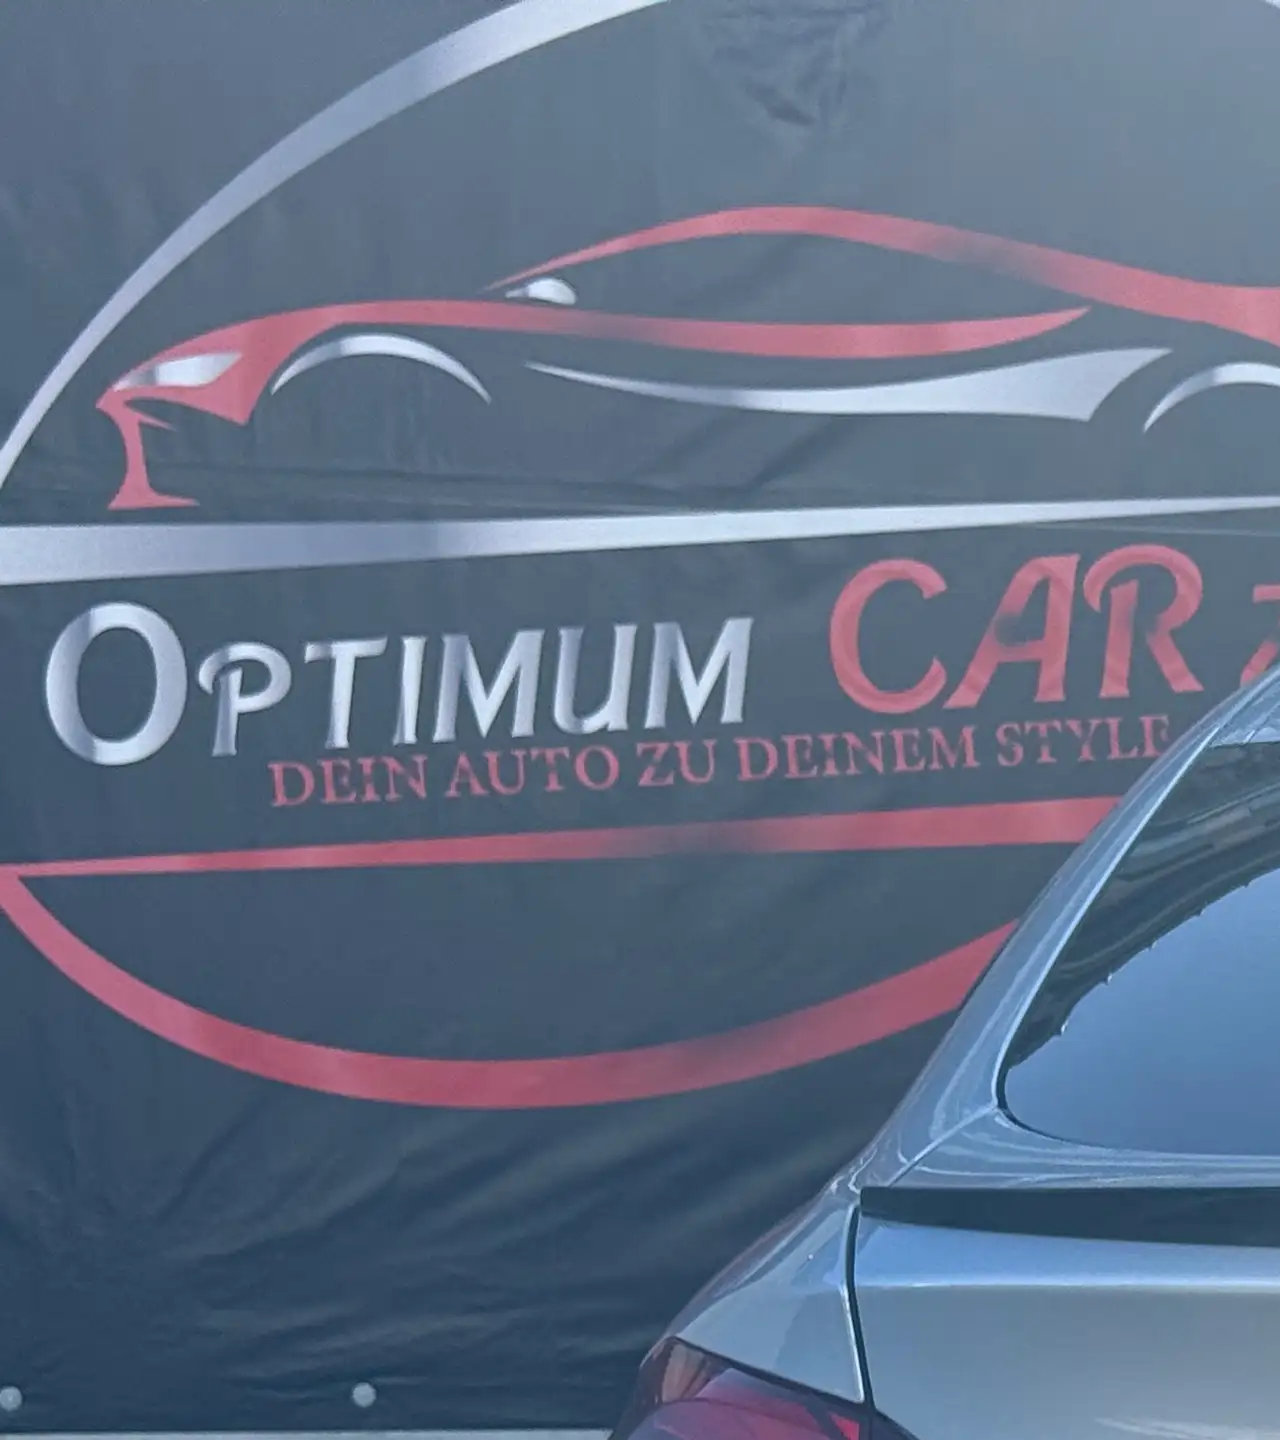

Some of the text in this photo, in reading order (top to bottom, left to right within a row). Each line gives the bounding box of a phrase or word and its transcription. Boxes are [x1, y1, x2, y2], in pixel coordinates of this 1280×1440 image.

[267, 713, 1170, 808] DEIN AUTO ZU DEINEM STYLE
